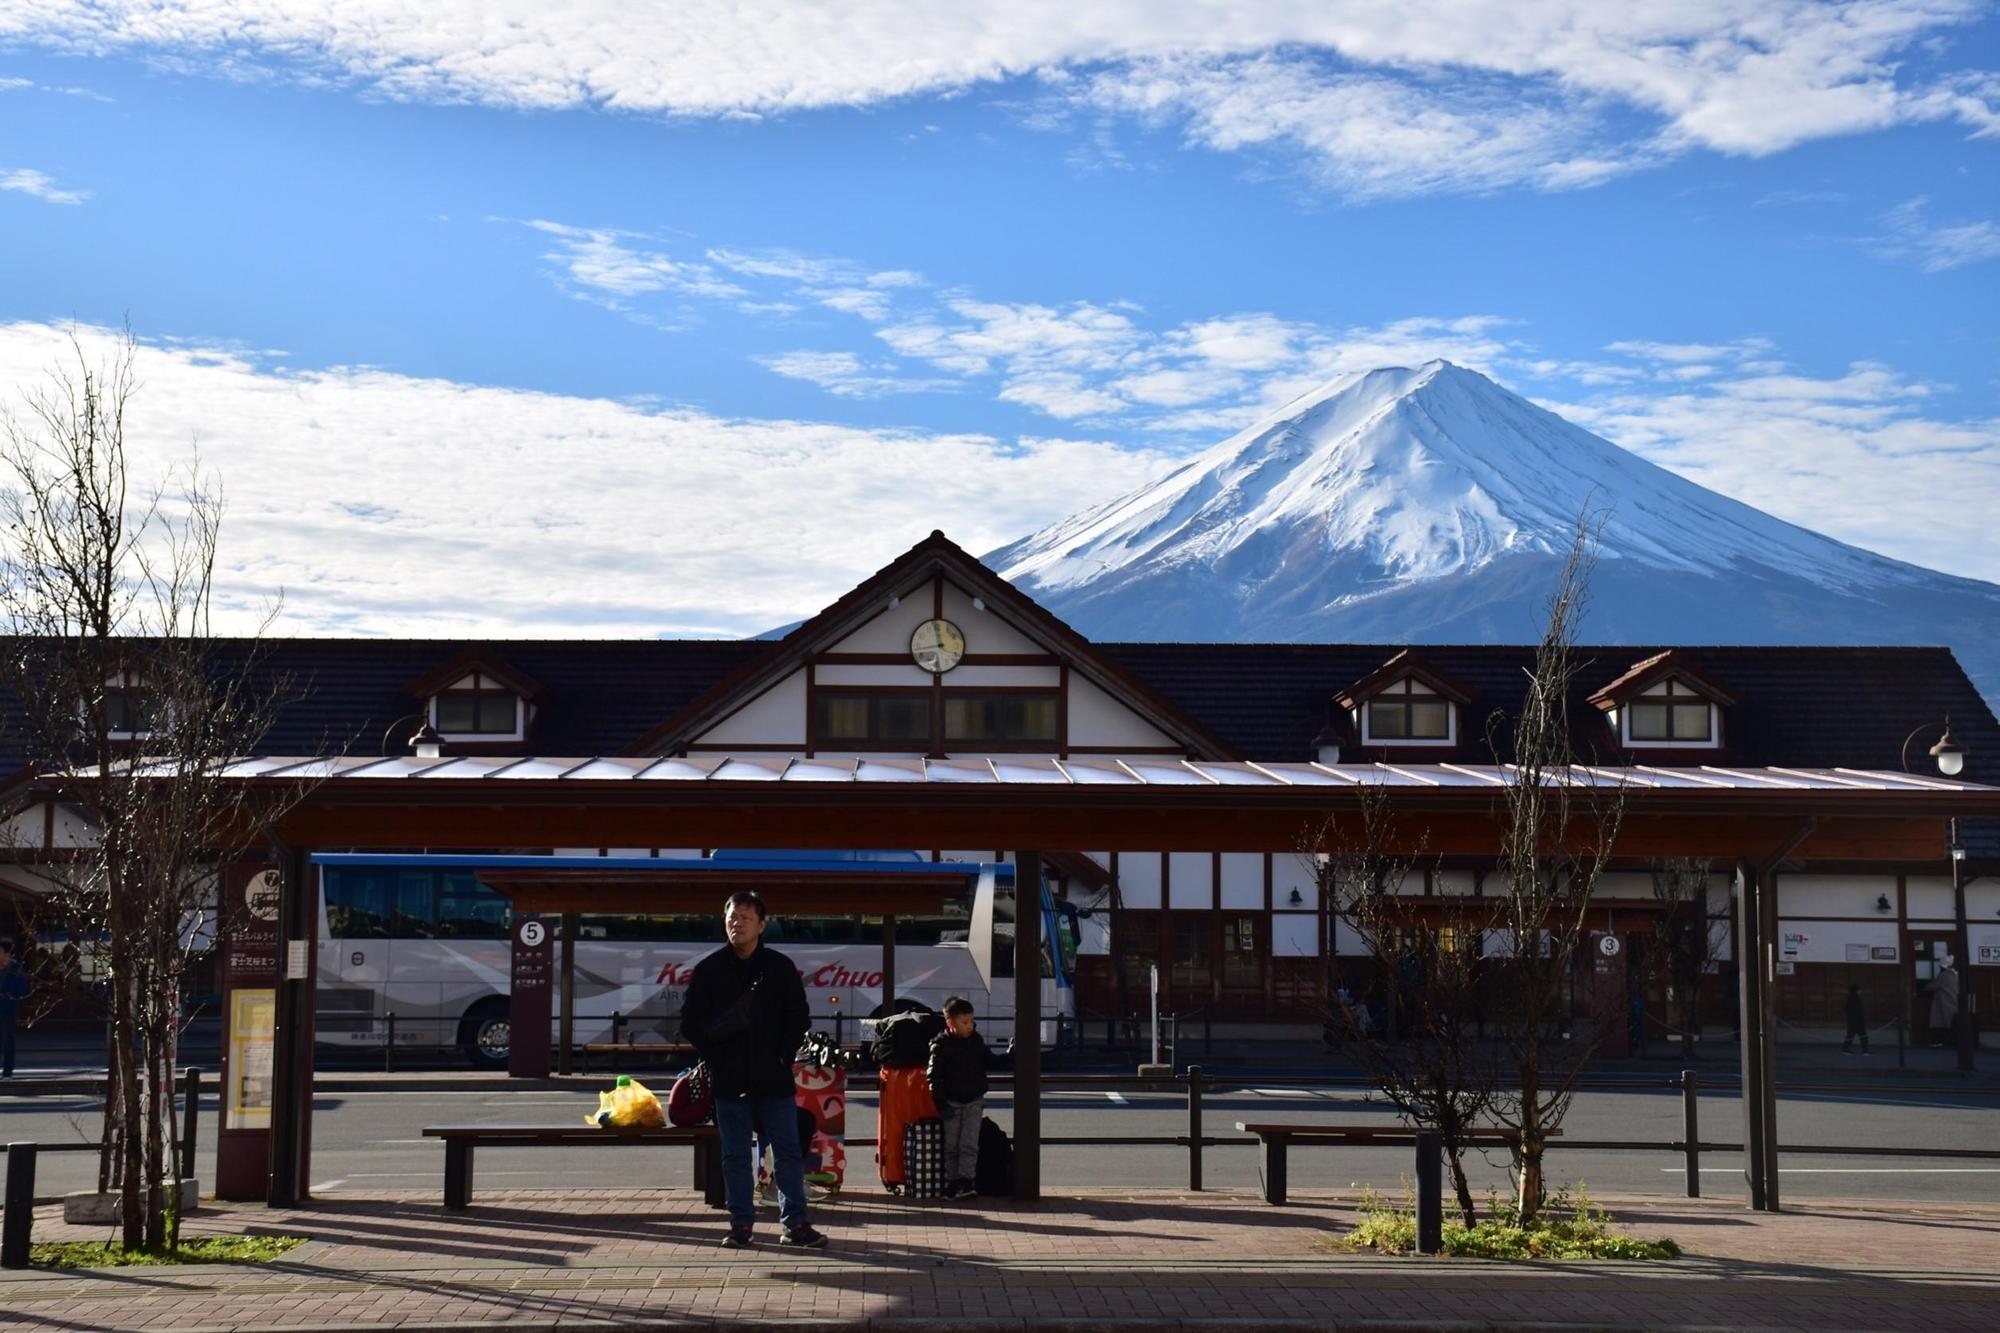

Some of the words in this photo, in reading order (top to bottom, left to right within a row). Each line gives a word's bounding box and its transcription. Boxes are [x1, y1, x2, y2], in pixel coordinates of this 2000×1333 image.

[527, 924, 538, 940] 5
[1606, 938, 1614, 951] 3
[813, 963, 885, 987] Chuo
[660, 991, 679, 1000] AIR
[801, 1067, 832, 1085] M
